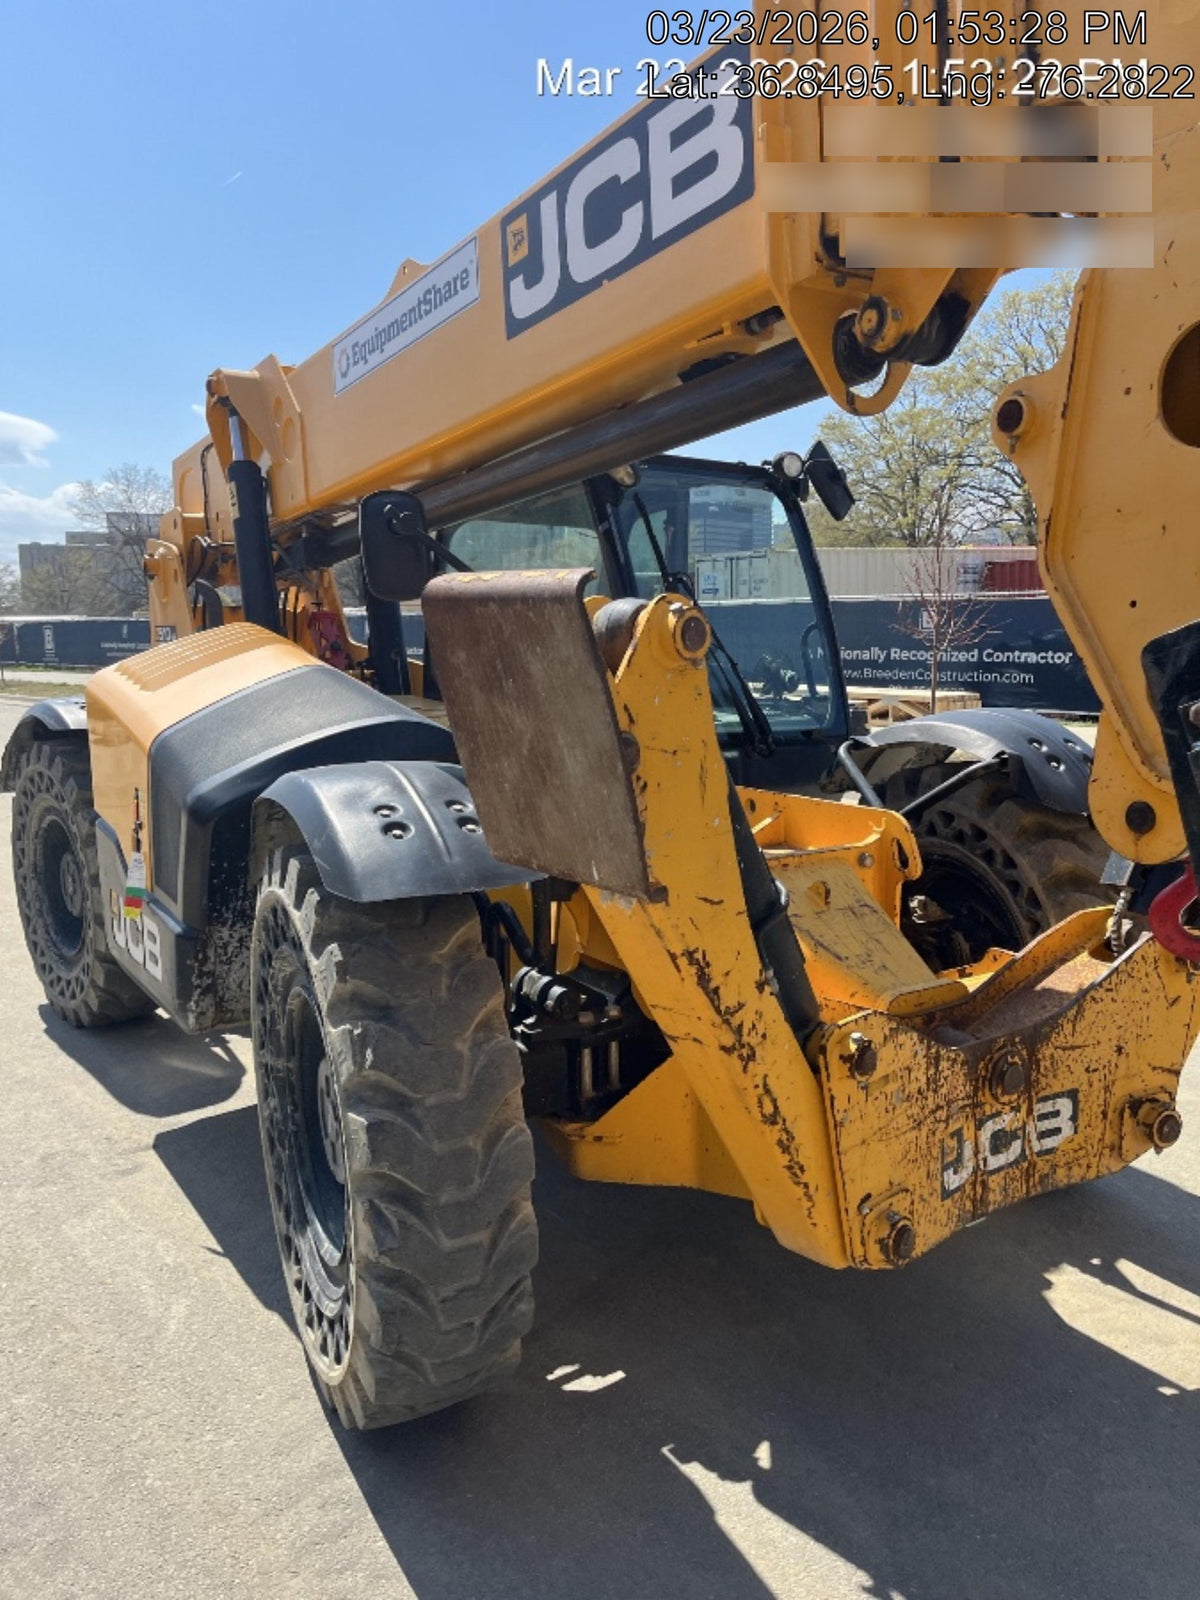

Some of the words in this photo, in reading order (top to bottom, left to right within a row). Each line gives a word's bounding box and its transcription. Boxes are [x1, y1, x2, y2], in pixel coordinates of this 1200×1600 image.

[509, 66, 744, 320] JCB
[350, 265, 471, 369] EquipmentShare
[890, 647, 979, 664] Recognized
[982, 648, 1074, 664] Contractor
[113, 894, 163, 983] JCB
[943, 1096, 1078, 1192] JCB
